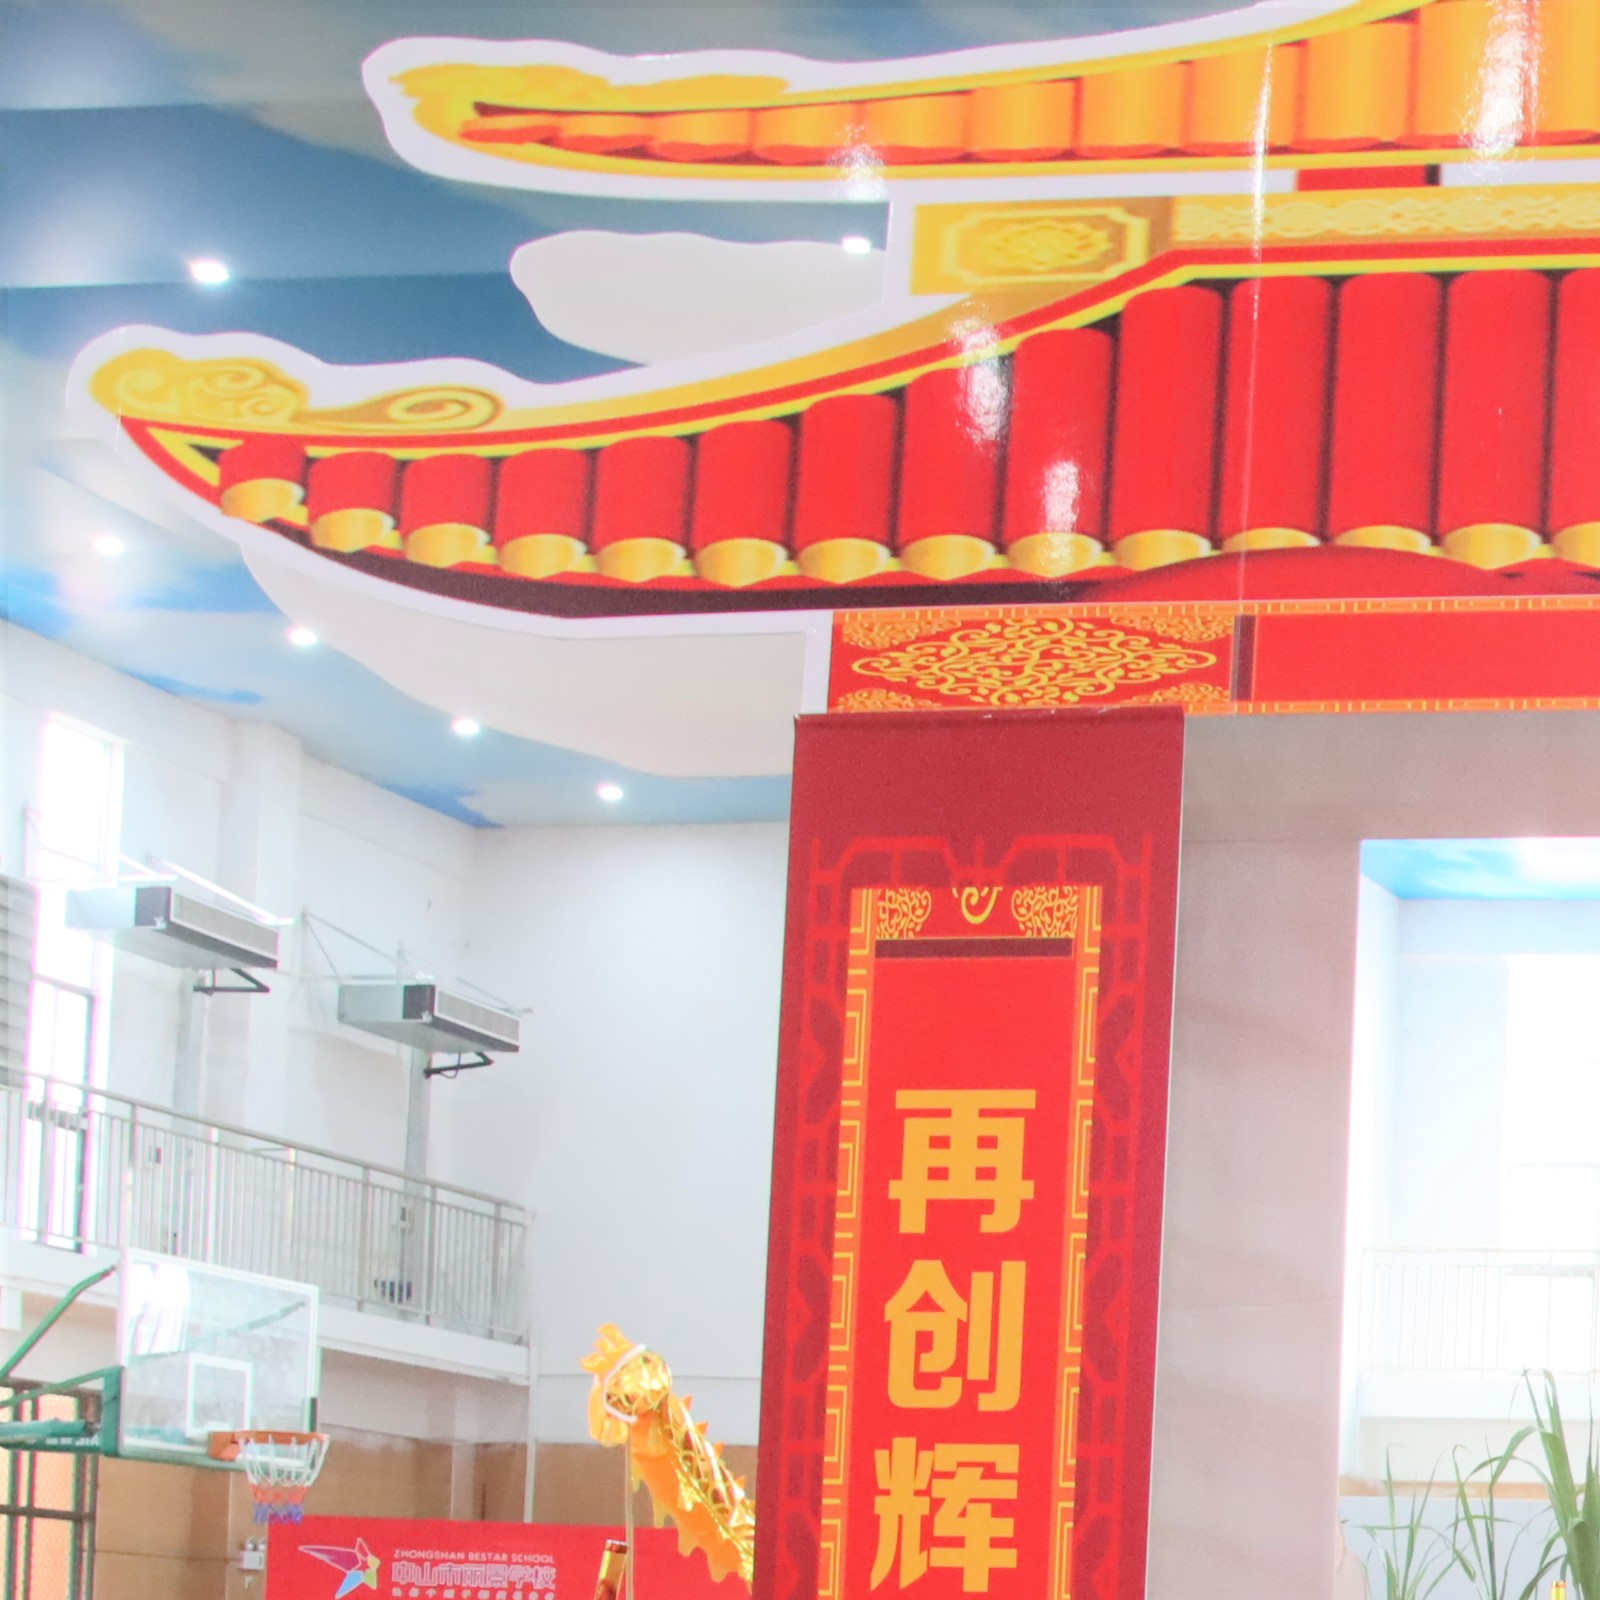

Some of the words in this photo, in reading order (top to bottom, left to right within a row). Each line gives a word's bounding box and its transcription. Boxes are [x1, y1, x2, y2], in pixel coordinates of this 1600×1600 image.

[393, 1549, 466, 1561] ZHONGSHAN
[467, 1551, 508, 1562] BESTAR
[511, 1553, 555, 1564] SCHOOL
[391, 1560, 557, 1590] 中山市丽景学校
